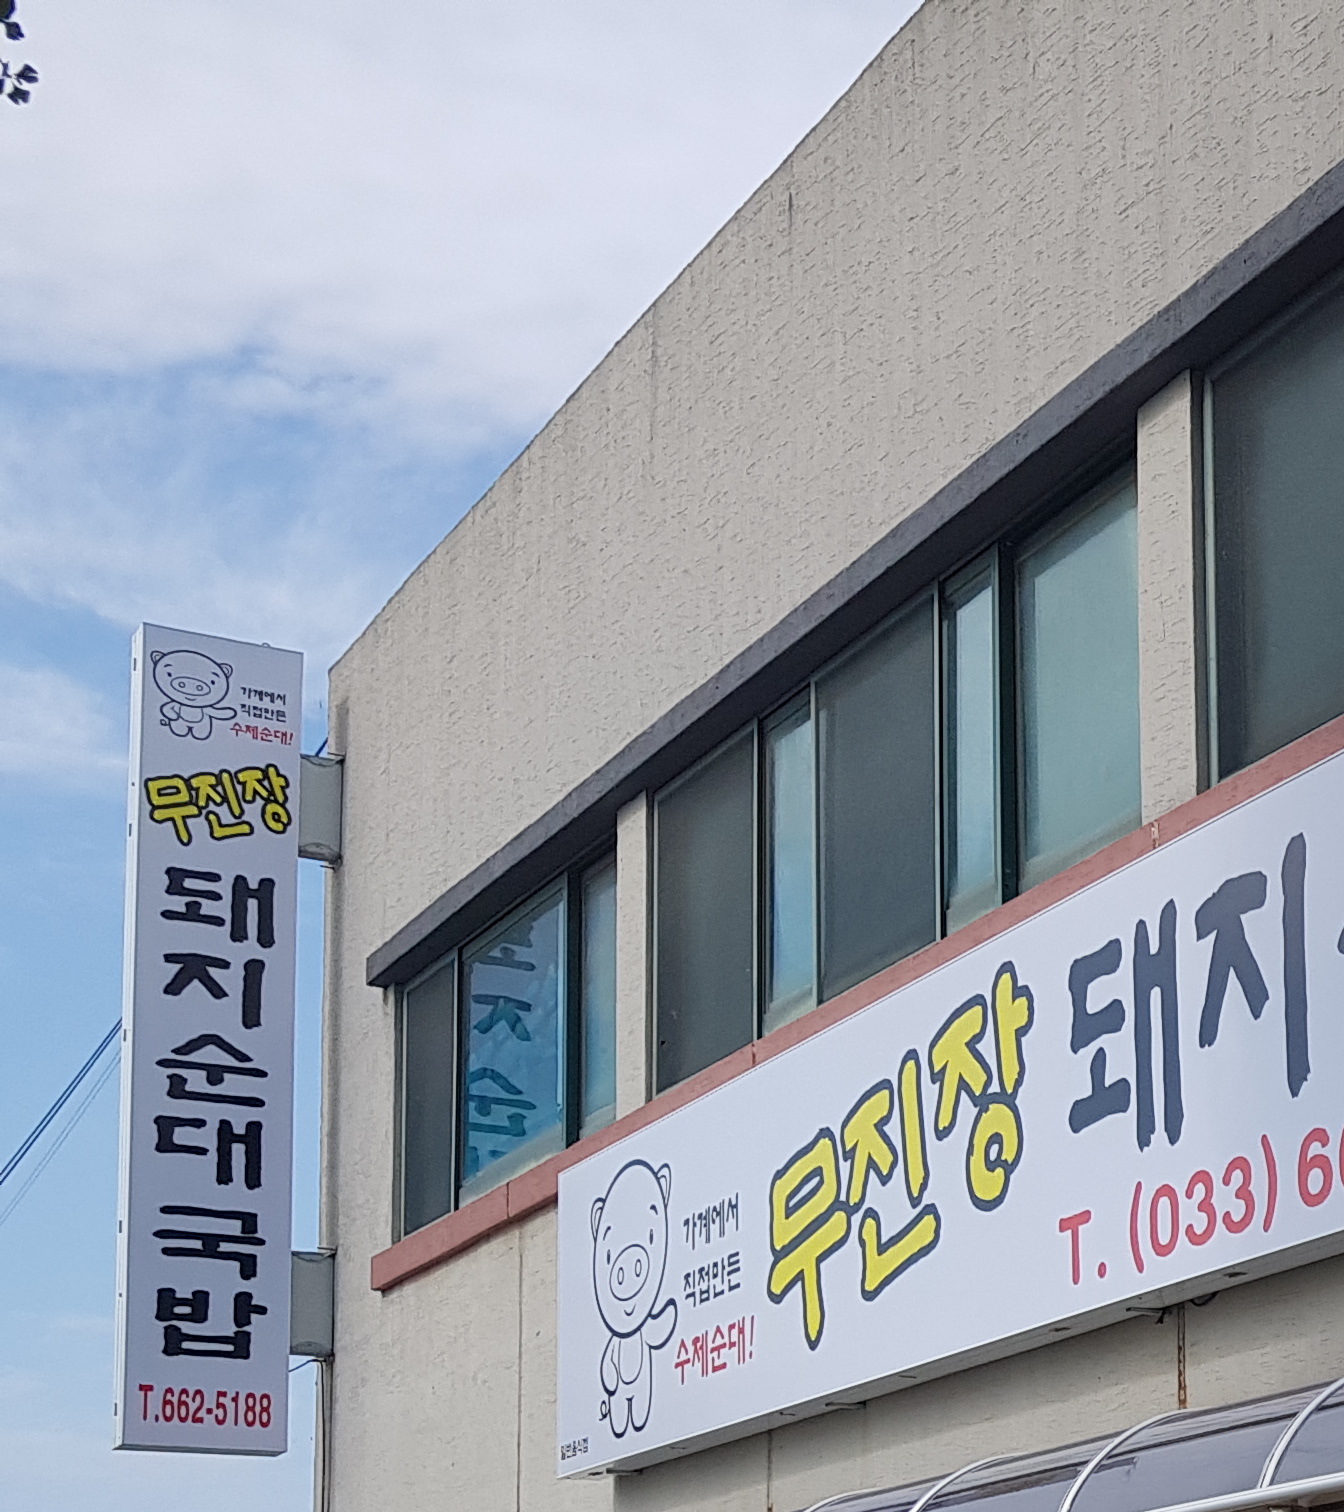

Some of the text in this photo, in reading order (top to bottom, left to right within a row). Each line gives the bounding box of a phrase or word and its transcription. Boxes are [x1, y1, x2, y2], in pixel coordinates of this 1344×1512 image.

[146, 763, 291, 846] 무진장
[767, 961, 1033, 1351] 무진장
[1129, 1133, 1277, 1273] (033)
[684, 1251, 741, 1308] 직접만든
[674, 1315, 755, 1385] 수제순대!
